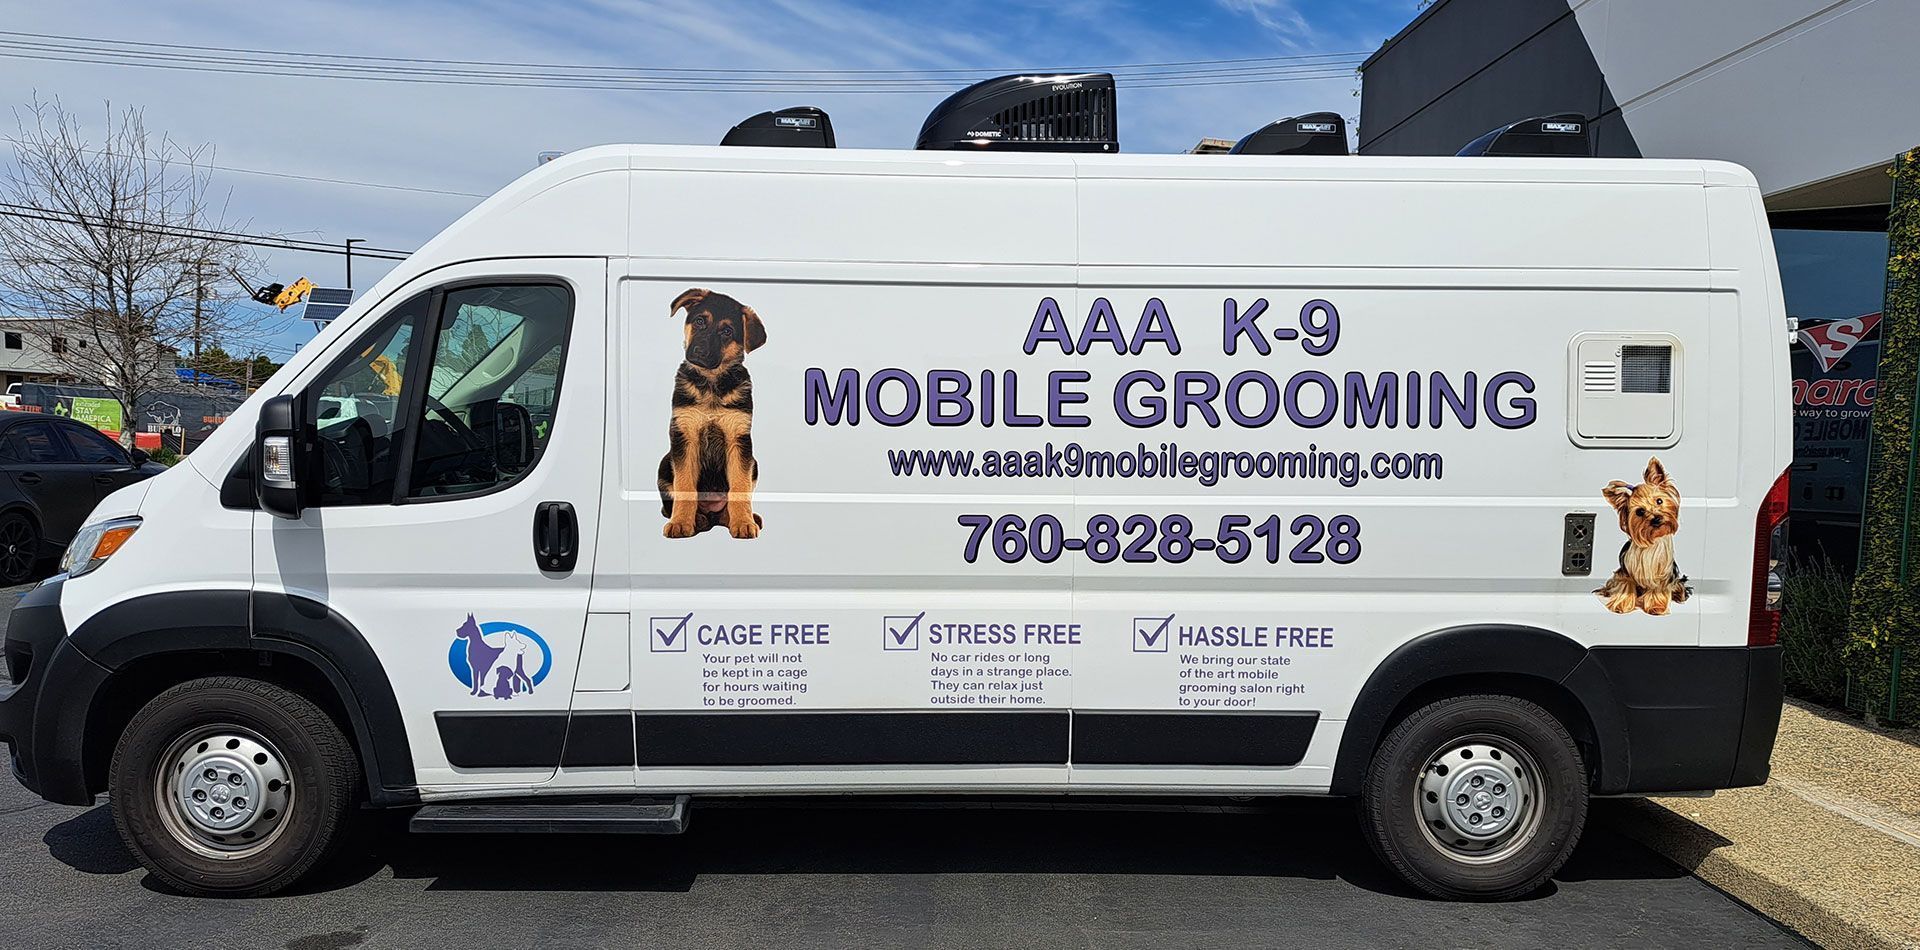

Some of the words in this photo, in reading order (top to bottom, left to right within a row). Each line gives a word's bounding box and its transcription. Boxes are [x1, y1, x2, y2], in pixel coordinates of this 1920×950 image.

[1052, 82, 1083, 91] EVOLUTION
[1022, 296, 1182, 357] AAA
[1222, 297, 1341, 357] K-9
[1819, 317, 1864, 359] S
[804, 367, 1092, 429] MOBILE
[1112, 369, 1538, 430] GROOMING
[75, 407, 95, 415] STAY
[1800, 409, 1823, 420] way
[1825, 408, 1838, 418] to
[1840, 409, 1873, 420] grow
[76, 414, 112, 423] AMERICA
[147, 424, 182, 434] BUFFLO
[887, 441, 1443, 488] www.aaak9mobilegrooming.com
[957, 513, 1362, 565] 760-828-5128
[697, 624, 763, 646] CAGE
[770, 623, 830, 645] FREE
[928, 623, 1017, 645] STRESS
[1024, 623, 1082, 645] FREE
[1178, 625, 1268, 647] HASSLE
[1275, 626, 1334, 648] FREE
[702, 653, 732, 664] Your
[734, 653, 755, 666] pet
[757, 652, 779, 663] will
[782, 652, 803, 663] not
[931, 652, 948, 663] No
[950, 654, 972, 663] car
[974, 651, 1005, 663] rides
[1008, 654, 1022, 663] or
[1024, 652, 1050, 665] long
[1179, 654, 1199, 665] We
[1202, 654, 1234, 668] bring
[1236, 657, 1259, 666] our
[1260, 655, 1291, 666] state
[702, 667, 719, 678] be
[721, 667, 750, 680] kept
[752, 667, 763, 678] in
[766, 669, 774, 678] a
[777, 669, 808, 680] cage
[930, 666, 959, 679] days
[962, 666, 973, 677] in
[976, 668, 984, 677] a
[986, 666, 1033, 679] strange
[1035, 666, 1072, 679] place.
[1179, 667, 1193, 679] of
[1194, 668, 1214, 679] the
[1216, 669, 1235, 679] art
[1237, 669, 1279, 680] mobile
[702, 681, 721, 693] for
[723, 681, 760, 692] hours
[762, 681, 808, 694] waiting
[930, 680, 960, 693] They
[962, 682, 985, 691] can
[988, 680, 1018, 691] relax
[1019, 680, 1044, 693] just
[1178, 682, 1237, 696] grooming
[1239, 683, 1273, 694] salon
[1276, 683, 1305, 696] right
[702, 696, 716, 707] to
[718, 695, 735, 706] be
[737, 695, 797, 709] groomed.
[930, 694, 976, 705] outside
[978, 693, 1007, 704] their
[1009, 694, 1046, 705] home.
[1178, 696, 1191, 706] to
[1193, 698, 1222, 709] your
[1223, 696, 1256, 707] door!
